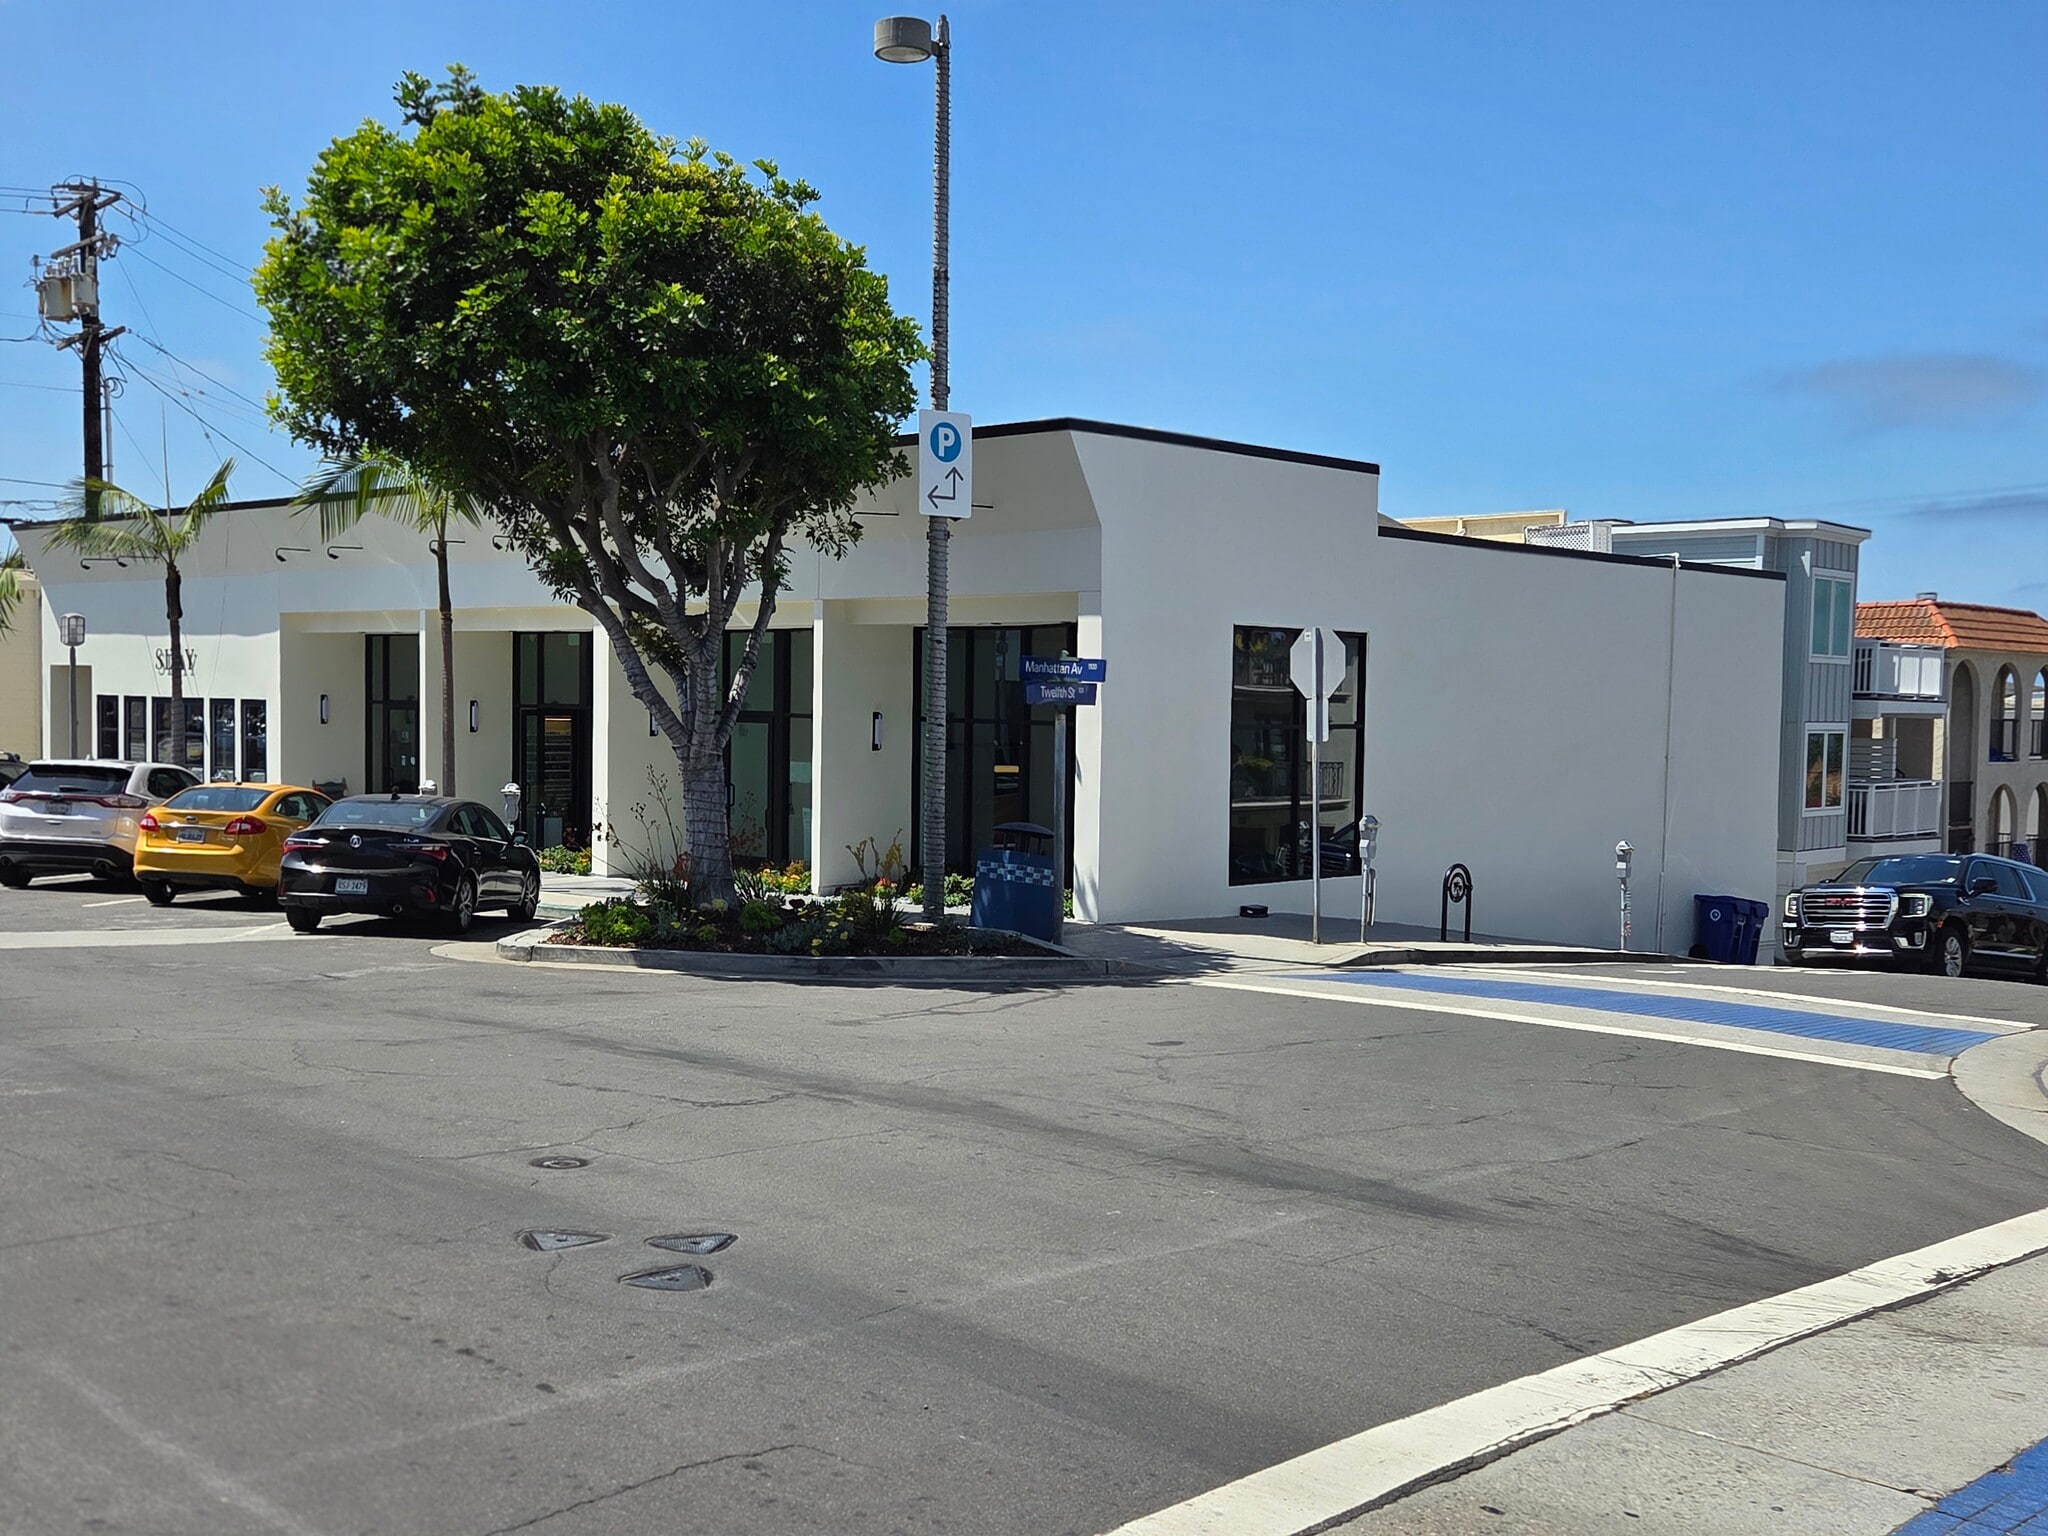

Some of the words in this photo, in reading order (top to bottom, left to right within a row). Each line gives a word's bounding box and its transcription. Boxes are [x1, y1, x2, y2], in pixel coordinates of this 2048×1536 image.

[938, 426, 955, 457] P
[1025, 661, 1070, 674] Manhattan
[1071, 663, 1083, 675] Av
[1040, 686, 1067, 698] Twelfth
[1068, 687, 1075, 699] St
